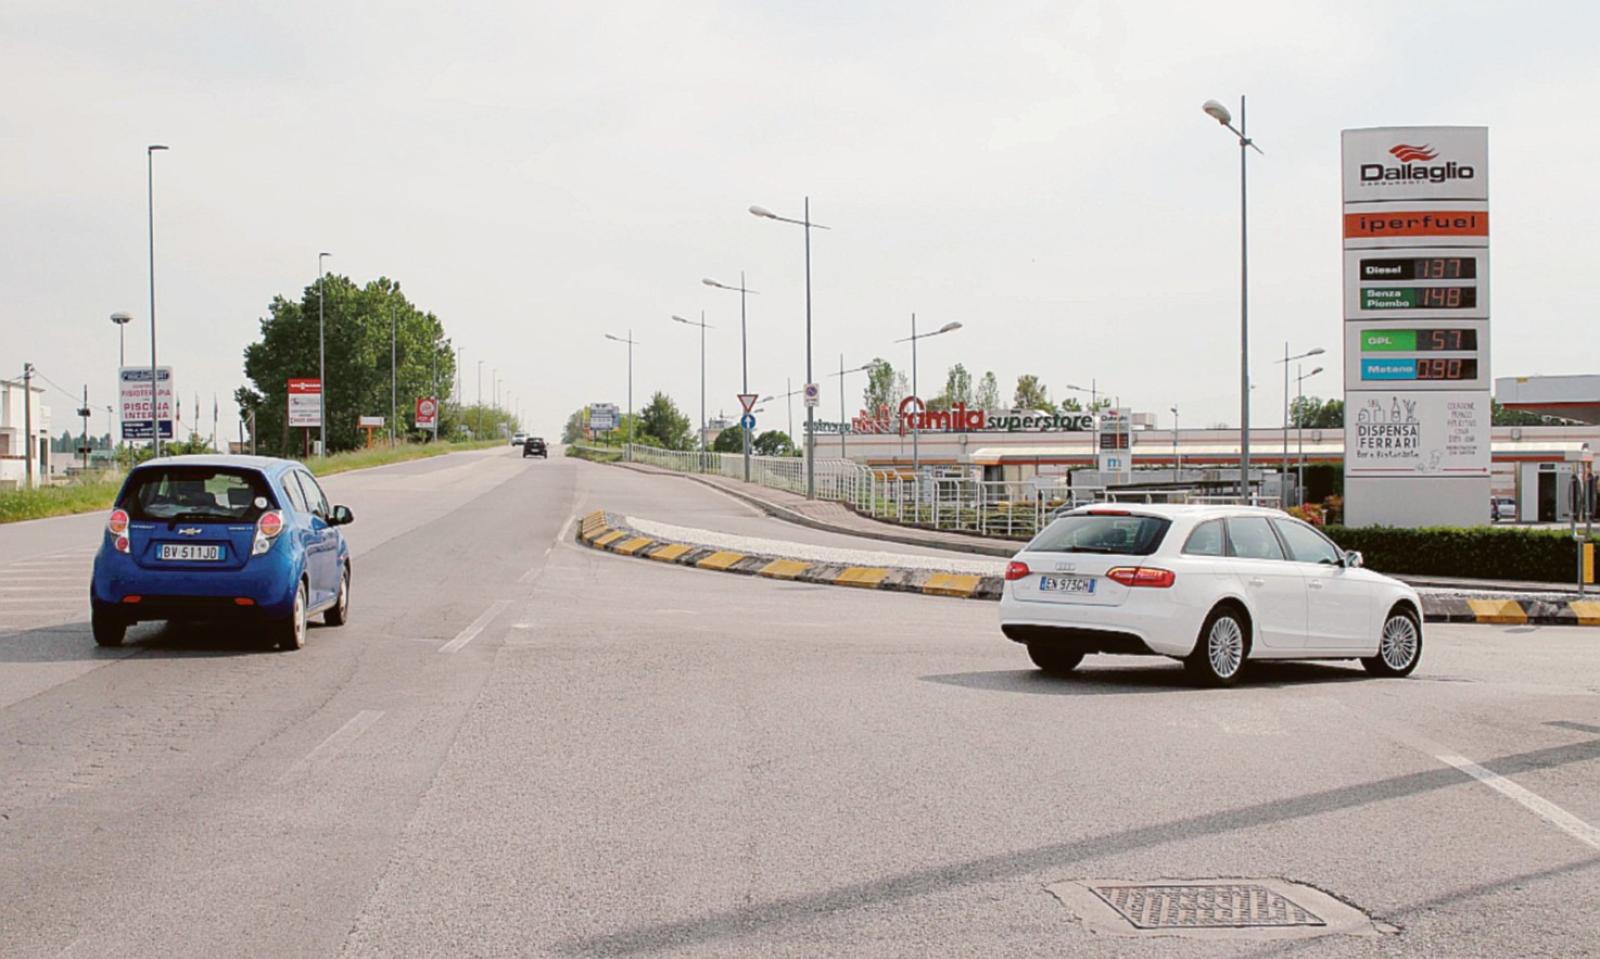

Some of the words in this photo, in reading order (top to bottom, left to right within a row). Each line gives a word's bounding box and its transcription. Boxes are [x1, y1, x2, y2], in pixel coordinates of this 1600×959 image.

[1360, 162, 1474, 183] Dallaglio
[1360, 215, 1476, 232] iperfuel
[1365, 266, 1401, 274] Diesel
[1423, 287, 1461, 307] 148
[1367, 300, 1410, 308] Piombo
[1432, 331, 1462, 349] 57
[1368, 366, 1413, 374] Metano
[122, 389, 171, 397] FISIOTERPIA
[896, 396, 985, 437] famila
[988, 414, 1093, 432] superstore
[1358, 425, 1417, 437] DISPENSA
[1360, 437, 1416, 448] FERRARI
[164, 546, 177, 558] BV
